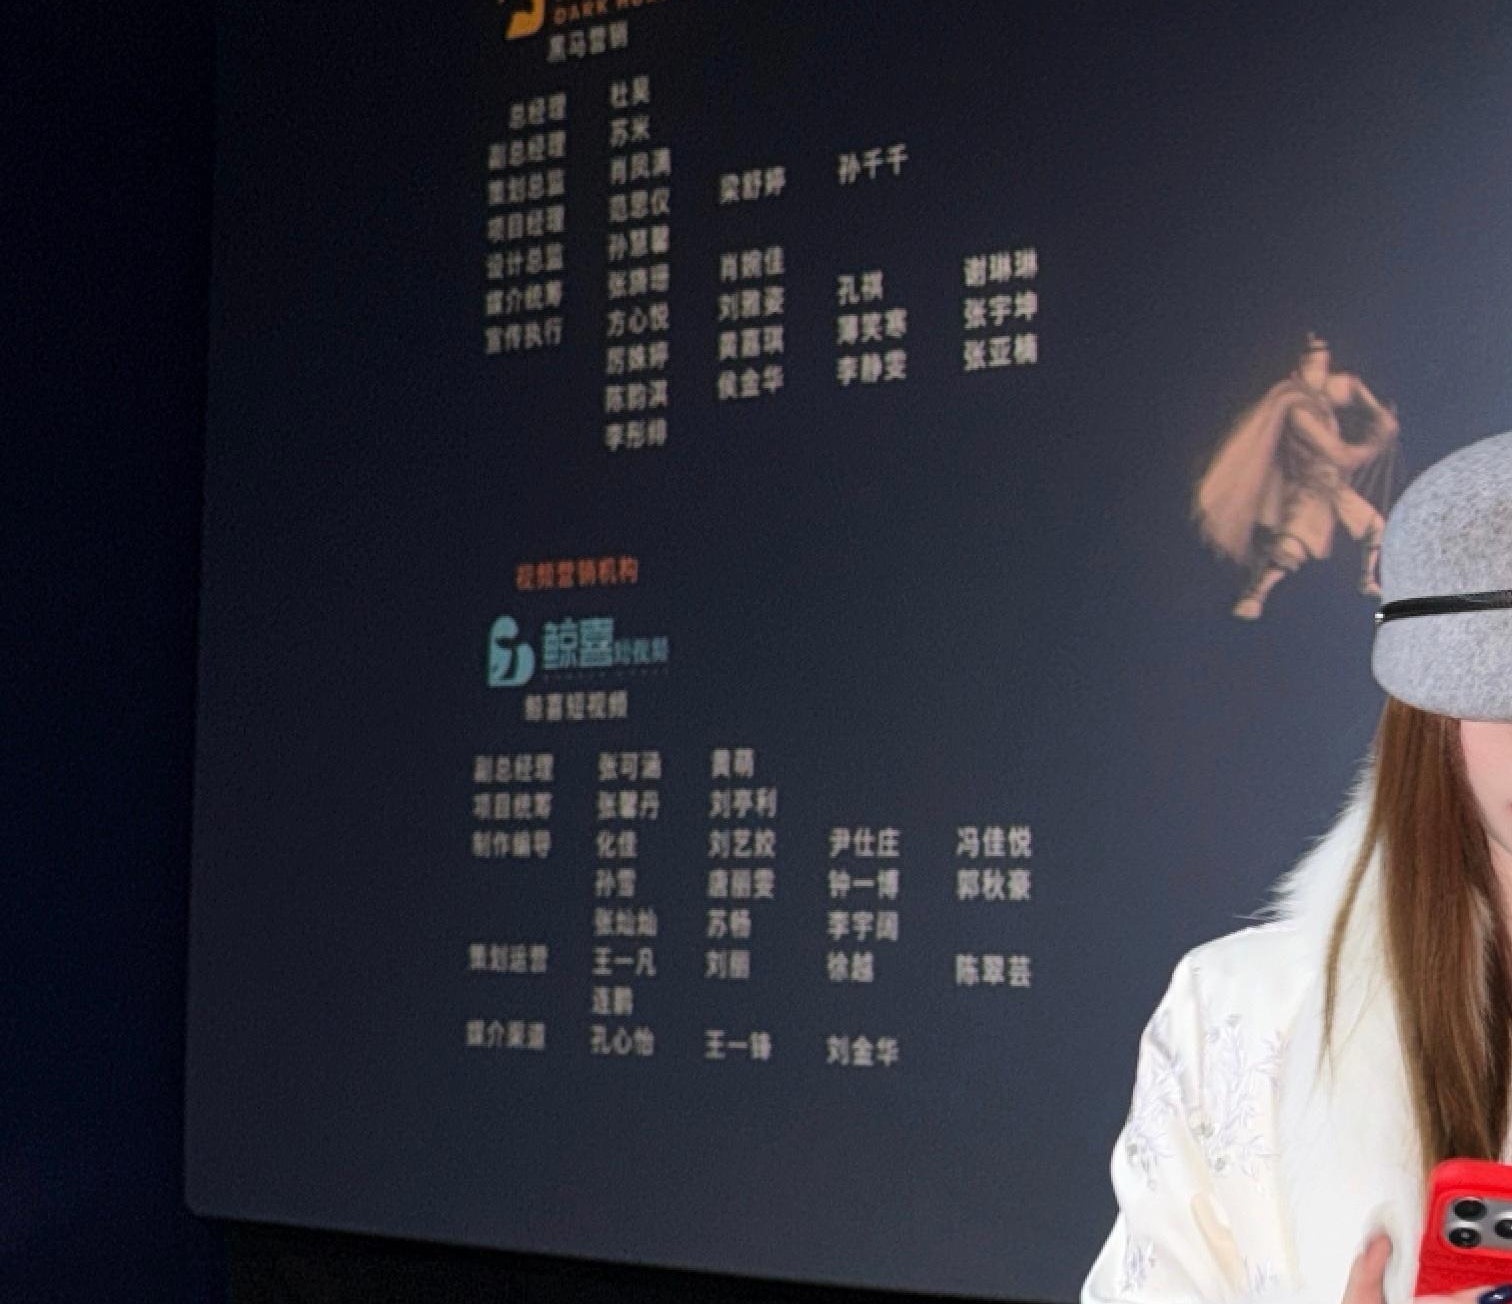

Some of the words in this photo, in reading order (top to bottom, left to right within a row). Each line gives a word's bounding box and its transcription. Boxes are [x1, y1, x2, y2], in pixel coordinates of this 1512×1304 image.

[547, 20, 629, 63] 黑马营销
[508, 92, 567, 130] 总经理
[487, 130, 567, 171] 副总经理
[609, 115, 651, 148] 苏米
[487, 168, 565, 206] 策划总监
[487, 205, 565, 243] 项目经理
[720, 165, 787, 204] 梁舒婷
[837, 143, 909, 185] 孙千千
[486, 242, 564, 279] 设计总监
[485, 279, 563, 316] 媒介统筹
[485, 317, 562, 355] 宣传执行
[607, 301, 670, 337] 方心悦
[837, 269, 884, 306] 孔祺
[963, 247, 1039, 288] 谢琳琳
[963, 290, 1039, 330] 张宇坤
[717, 365, 784, 400] 侯金华
[836, 348, 907, 387] 李静雯
[963, 332, 1038, 372] 张亚楠
[515, 555, 639, 590] 视频营销机构
[524, 690, 628, 721] 鲸喜短视频
[473, 753, 554, 783] 副总经理
[473, 791, 553, 820] 项目统筹
[709, 786, 778, 819] 刘亭利
[472, 829, 552, 859] 制作编导
[596, 830, 638, 859] 化佳
[829, 826, 901, 858] 尹仕庄
[956, 825, 1033, 859] 冯佳悦
[595, 867, 637, 898] 孙雪
[827, 868, 900, 901] 钟一博
[956, 867, 1032, 901] 郭秋豪
[594, 907, 658, 937] 张灿灿
[469, 943, 548, 973] 策划运营
[593, 946, 657, 977] 王一凡
[826, 950, 875, 983] 徐越
[955, 953, 1032, 988] 陈翠芸
[467, 1019, 546, 1051] 媒介渠道
[591, 1024, 655, 1057] 孔心怡
[826, 1034, 900, 1067] 刘金华
